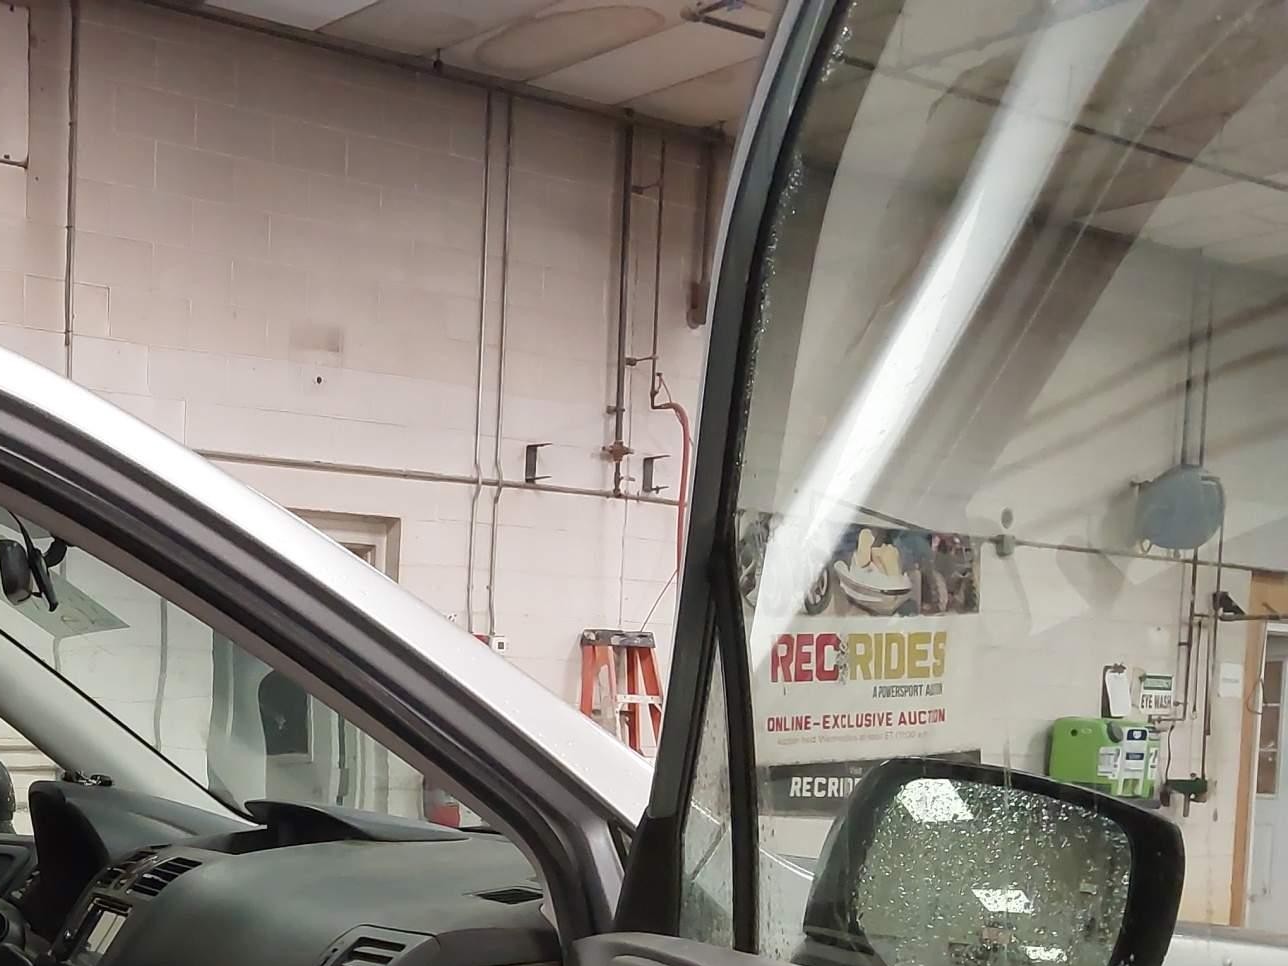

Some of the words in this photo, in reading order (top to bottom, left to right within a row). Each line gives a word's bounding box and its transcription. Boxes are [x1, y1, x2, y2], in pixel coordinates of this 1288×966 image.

[771, 634, 841, 682] REC
[848, 632, 947, 680] RIDES
[879, 684, 924, 698] POWERSPORT
[1141, 695, 1152, 708] EYE
[1154, 695, 1172, 708] WASH
[767, 712, 893, 732] ONLINE-EXCLUSIVE
[898, 708, 946, 725] AUCTION
